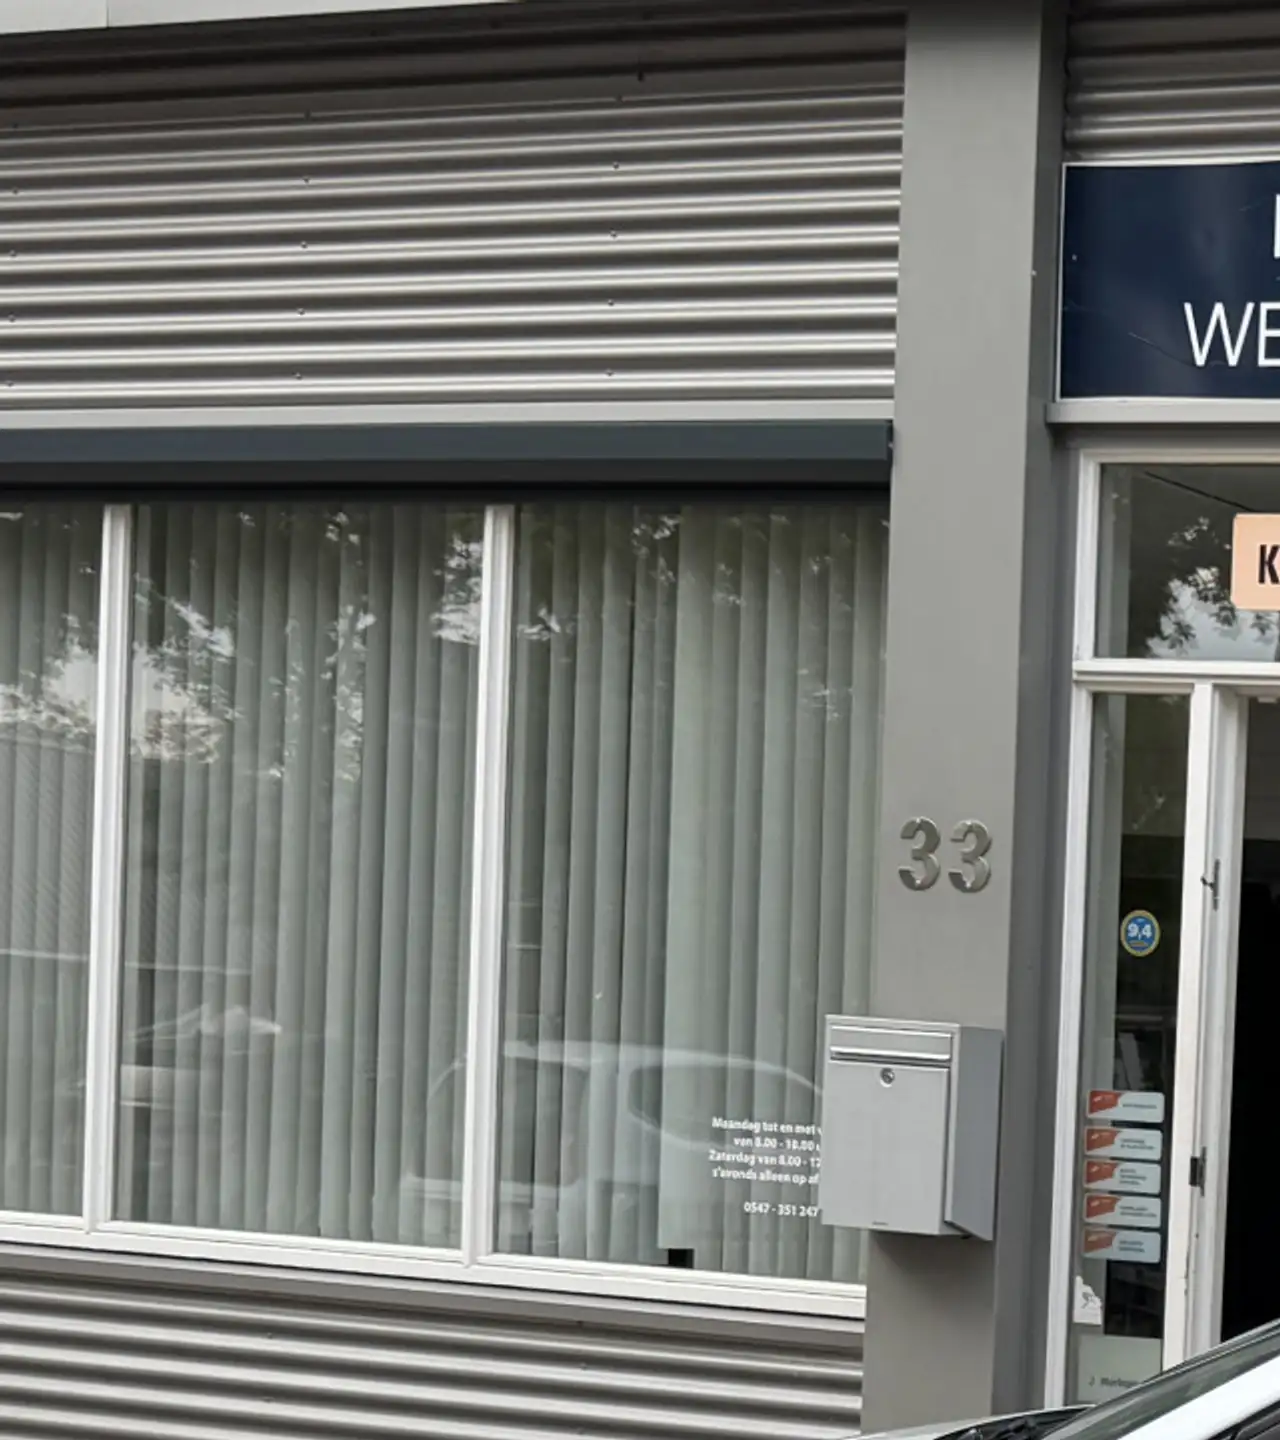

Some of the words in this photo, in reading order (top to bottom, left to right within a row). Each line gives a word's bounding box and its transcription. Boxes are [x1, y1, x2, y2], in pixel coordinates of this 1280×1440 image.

[897, 816, 993, 894] 33
[712, 1116, 761, 1134] Maandag
[762, 1121, 778, 1132] tot
[780, 1123, 793, 1133] en
[733, 1137, 753, 1147] van
[708, 1149, 756, 1167] Zaterdag
[758, 1155, 777, 1165] van
[759, 1169, 791, 1182] alleen
[792, 1174, 807, 1187] op
[778, 1204, 797, 1216] 351
